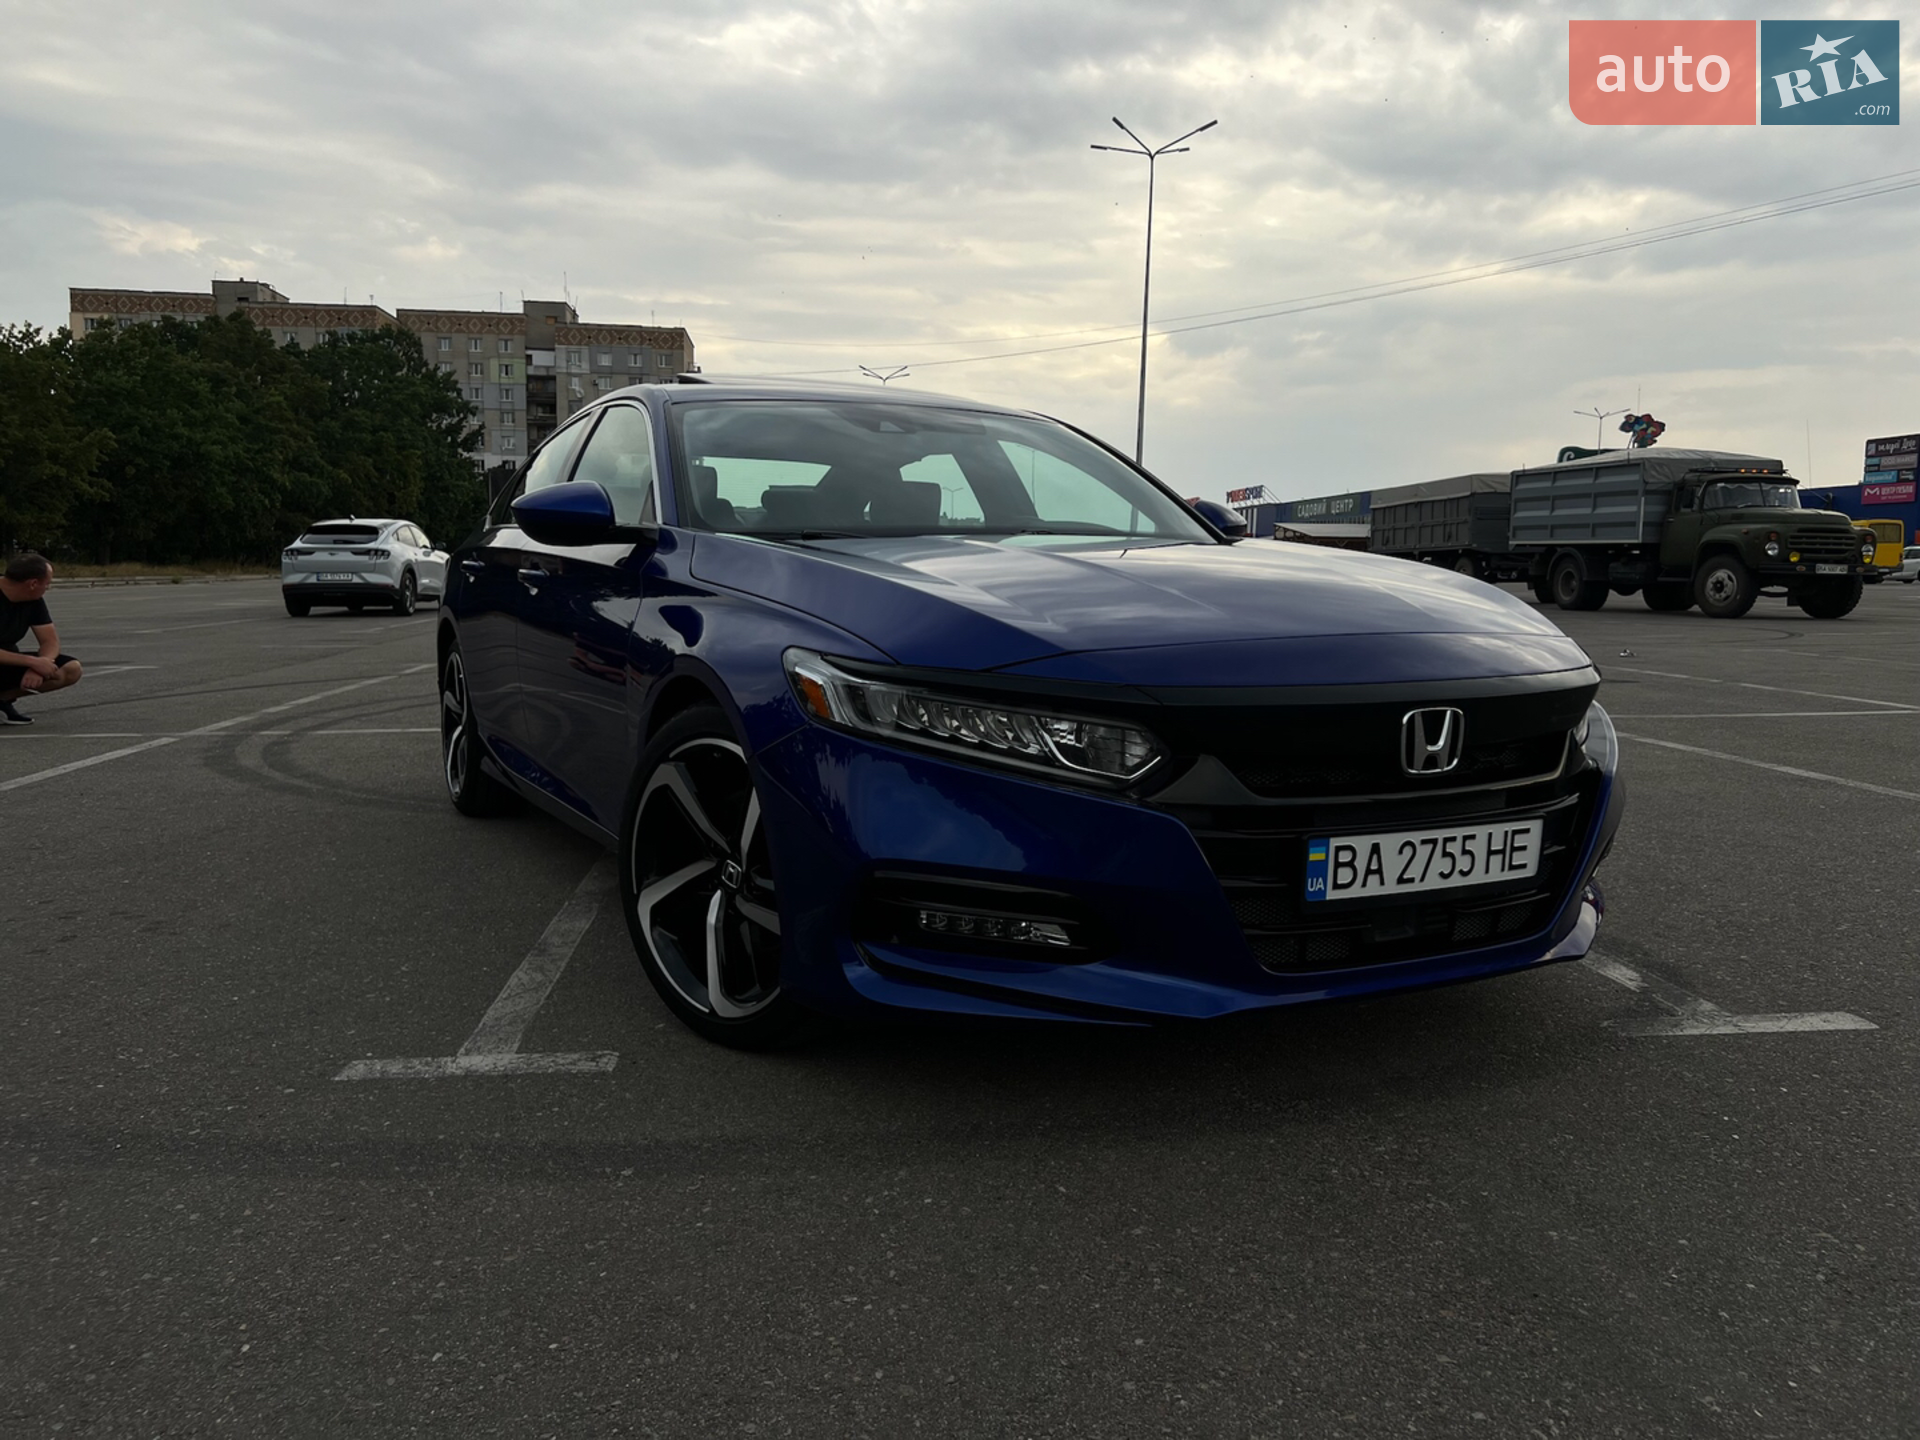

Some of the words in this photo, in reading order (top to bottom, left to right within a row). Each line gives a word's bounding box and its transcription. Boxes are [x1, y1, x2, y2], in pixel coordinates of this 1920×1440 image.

[1297, 500, 1327, 518] САДОВИЙ
[1331, 498, 1354, 515] ЦЕНТР
[1331, 841, 1386, 891] BA
[1396, 833, 1478, 886] 2755
[1484, 827, 1532, 875] HE
[1307, 876, 1325, 892] UA
